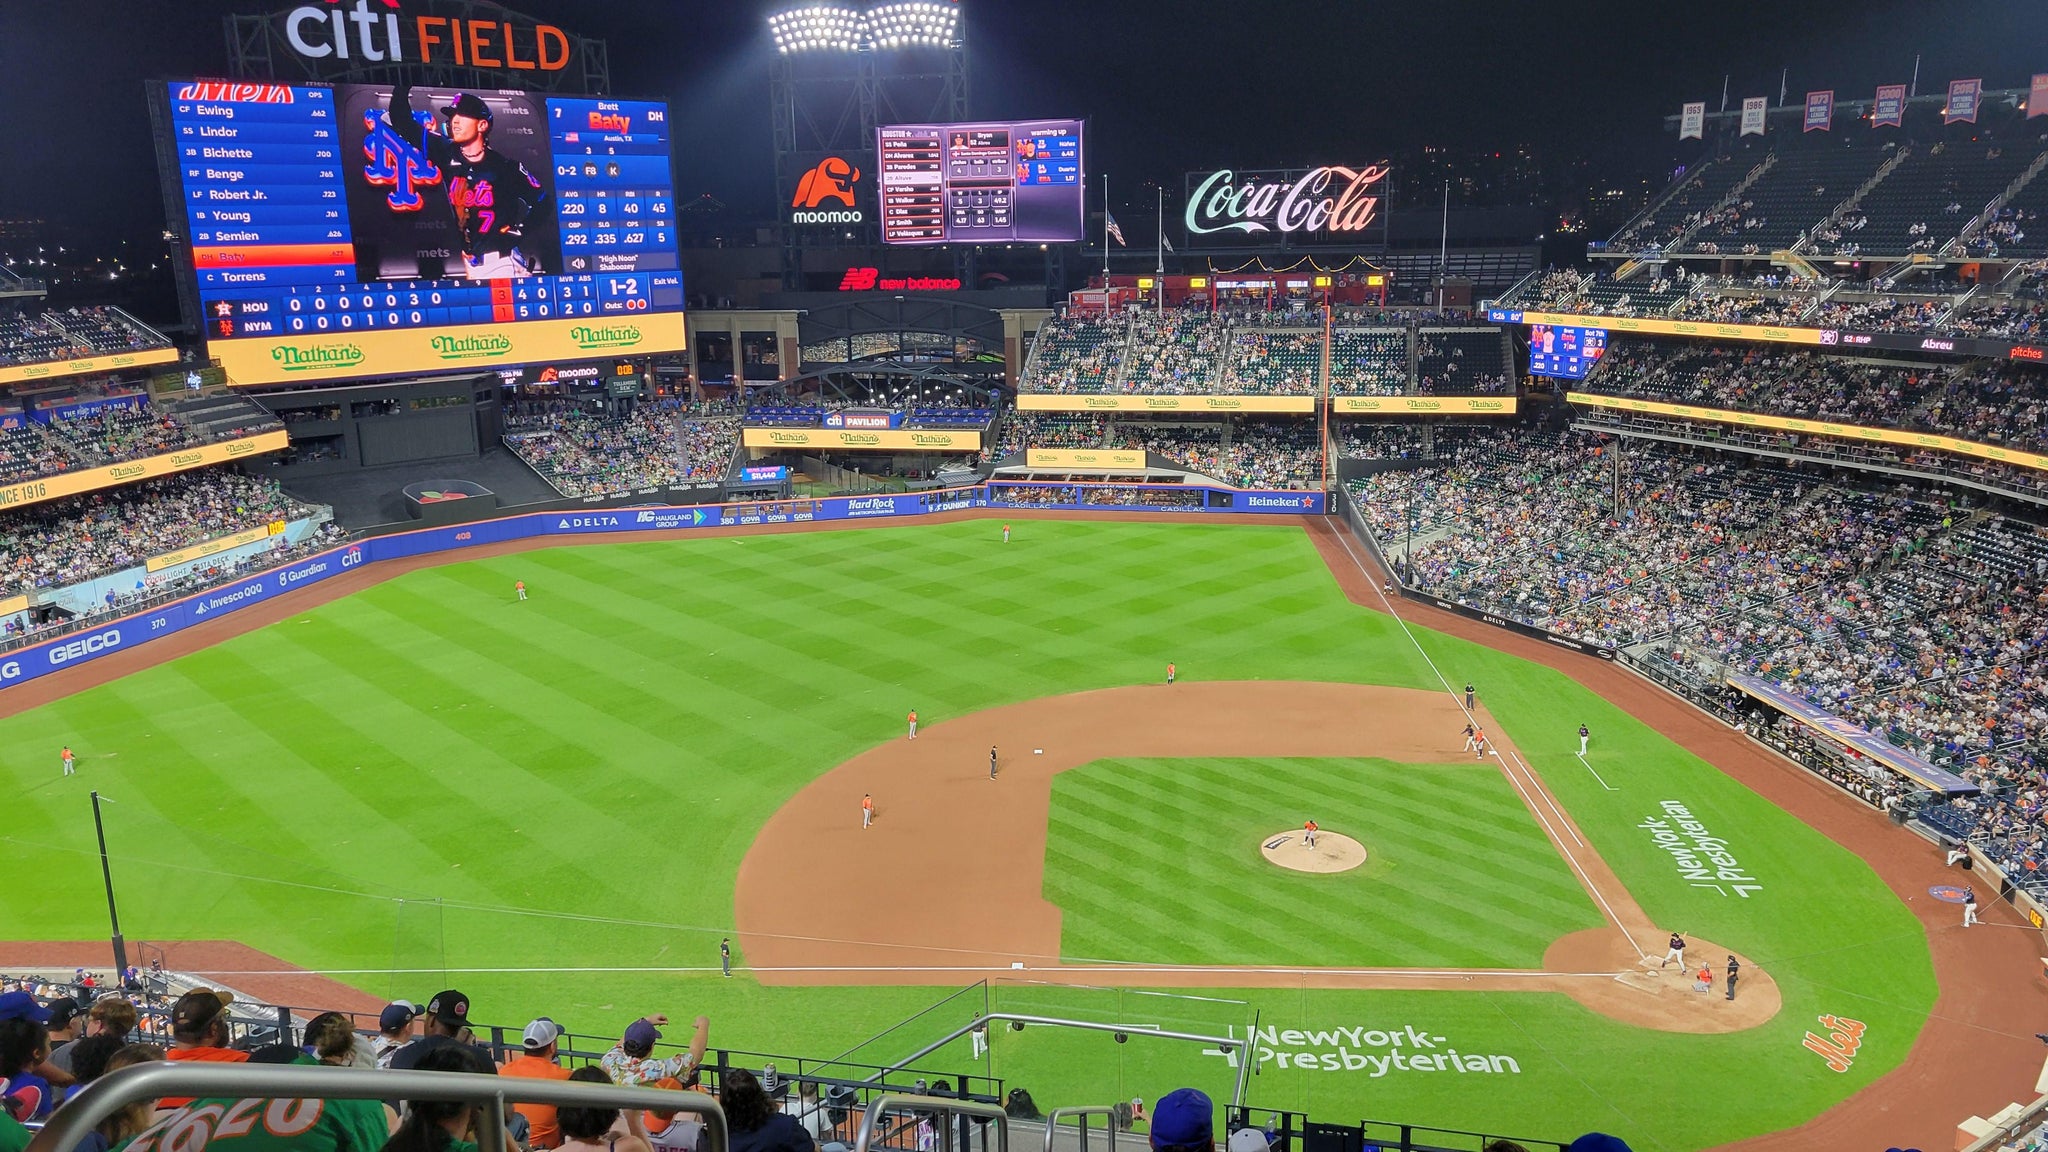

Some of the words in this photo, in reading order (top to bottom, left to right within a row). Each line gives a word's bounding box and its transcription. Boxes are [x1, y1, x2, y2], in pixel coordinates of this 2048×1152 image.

[286, 0, 402, 62] citi
[417, 16, 570, 71] FIELD
[308, 91, 323, 99] OPS
[598, 102, 619, 111] Brett
[1746, 100, 1763, 110] 1986
[197, 105, 234, 118] Ewing
[502, 107, 529, 115] mets
[555, 108, 562, 118] 7
[648, 112, 664, 121] DH
[588, 111, 631, 135] Baty
[183, 127, 194, 135] SS
[200, 126, 238, 137] Lindor
[1030, 128, 1057, 137] warming
[1058, 128, 1067, 137] up
[203, 147, 253, 159] Bichette
[206, 169, 245, 182] Benge
[557, 166, 577, 175] 0-2
[210, 190, 251, 200] Robert
[252, 190, 268, 200] Jr.
[1185, 165, 1390, 234] Coca-Cola
[561, 204, 585, 214] .220
[624, 203, 638, 214] 40
[652, 203, 666, 213] 45
[212, 211, 251, 223] Young
[477, 210, 495, 234] 7
[793, 211, 862, 223] moomoo
[216, 231, 260, 241] Semien
[565, 234, 588, 245] .292
[594, 233, 617, 245] .335
[623, 233, 644, 244] .627
[658, 233, 665, 243] 5
[201, 253, 213, 261] DH
[219, 252, 245, 263] Baty
[416, 248, 450, 259] mets
[221, 272, 266, 282] Torrens
[609, 278, 638, 296] 1-2
[880, 279, 906, 290] new
[907, 277, 961, 290] balance
[242, 302, 269, 313] HOU
[290, 299, 301, 311] 0
[315, 298, 325, 310] 0
[339, 296, 350, 309] 0
[363, 295, 374, 308] 0
[386, 294, 396, 306] 0
[604, 302, 623, 310] Outs:
[1492, 312, 1506, 320] 9:26
[244, 321, 272, 331] NYM
[292, 317, 303, 330] 0
[570, 324, 641, 344] Nathan's
[1584, 329, 1595, 337] Bot
[431, 333, 511, 354] Nathan's
[1843, 335, 1853, 343] 52
[1855, 336, 1872, 344] RHP
[1921, 339, 1954, 350] Abreu
[271, 343, 363, 365] Nathan's
[2010, 347, 2043, 360] pitches
[558, 367, 598, 378] moomoo
[1568, 365, 1578, 373] 40
[1084, 397, 1120, 408] Nathan's
[1145, 397, 1180, 408] Nathan's
[1206, 398, 1242, 409] Nathan's
[62, 410, 77, 418] THE
[826, 416, 843, 426] citi
[846, 417, 887, 427] PAVILION
[769, 431, 809, 443] Nathan's
[840, 432, 880, 444] Nathan's
[911, 433, 953, 445] Nathan's
[751, 472, 777, 480] $11,440
[21, 483, 47, 500] 1916
[848, 499, 872, 510] Hard
[872, 498, 894, 509] Rock
[975, 499, 987, 507] 370
[1248, 496, 1300, 508] Heineken
[1160, 505, 1206, 513] CADILLAC
[574, 517, 619, 527] DELTA
[655, 513, 692, 521] HAUGLAND
[720, 517, 735, 526] 380
[740, 516, 760, 524] GOYA
[767, 514, 787, 523] GOYA
[793, 512, 813, 521] GOYA
[656, 520, 679, 528] GROUP
[455, 531, 472, 541] 408
[212, 554, 230, 567] DECK
[167, 567, 187, 581] LIGHT
[288, 562, 327, 582] Guardian
[209, 592, 244, 610] Invesco
[244, 583, 263, 598] QQQ
[151, 617, 166, 630] 370
[1488, 616, 1506, 627] DELTA
[49, 629, 121, 665] GEICO
[1659, 800, 1756, 881] Presbyterian
[1637, 815, 1716, 880] NewYork-
[1248, 1025, 1447, 1049] NewYork-
[1802, 1013, 1868, 1073] Mets
[1258, 1047, 1522, 1078] Presbyterian
